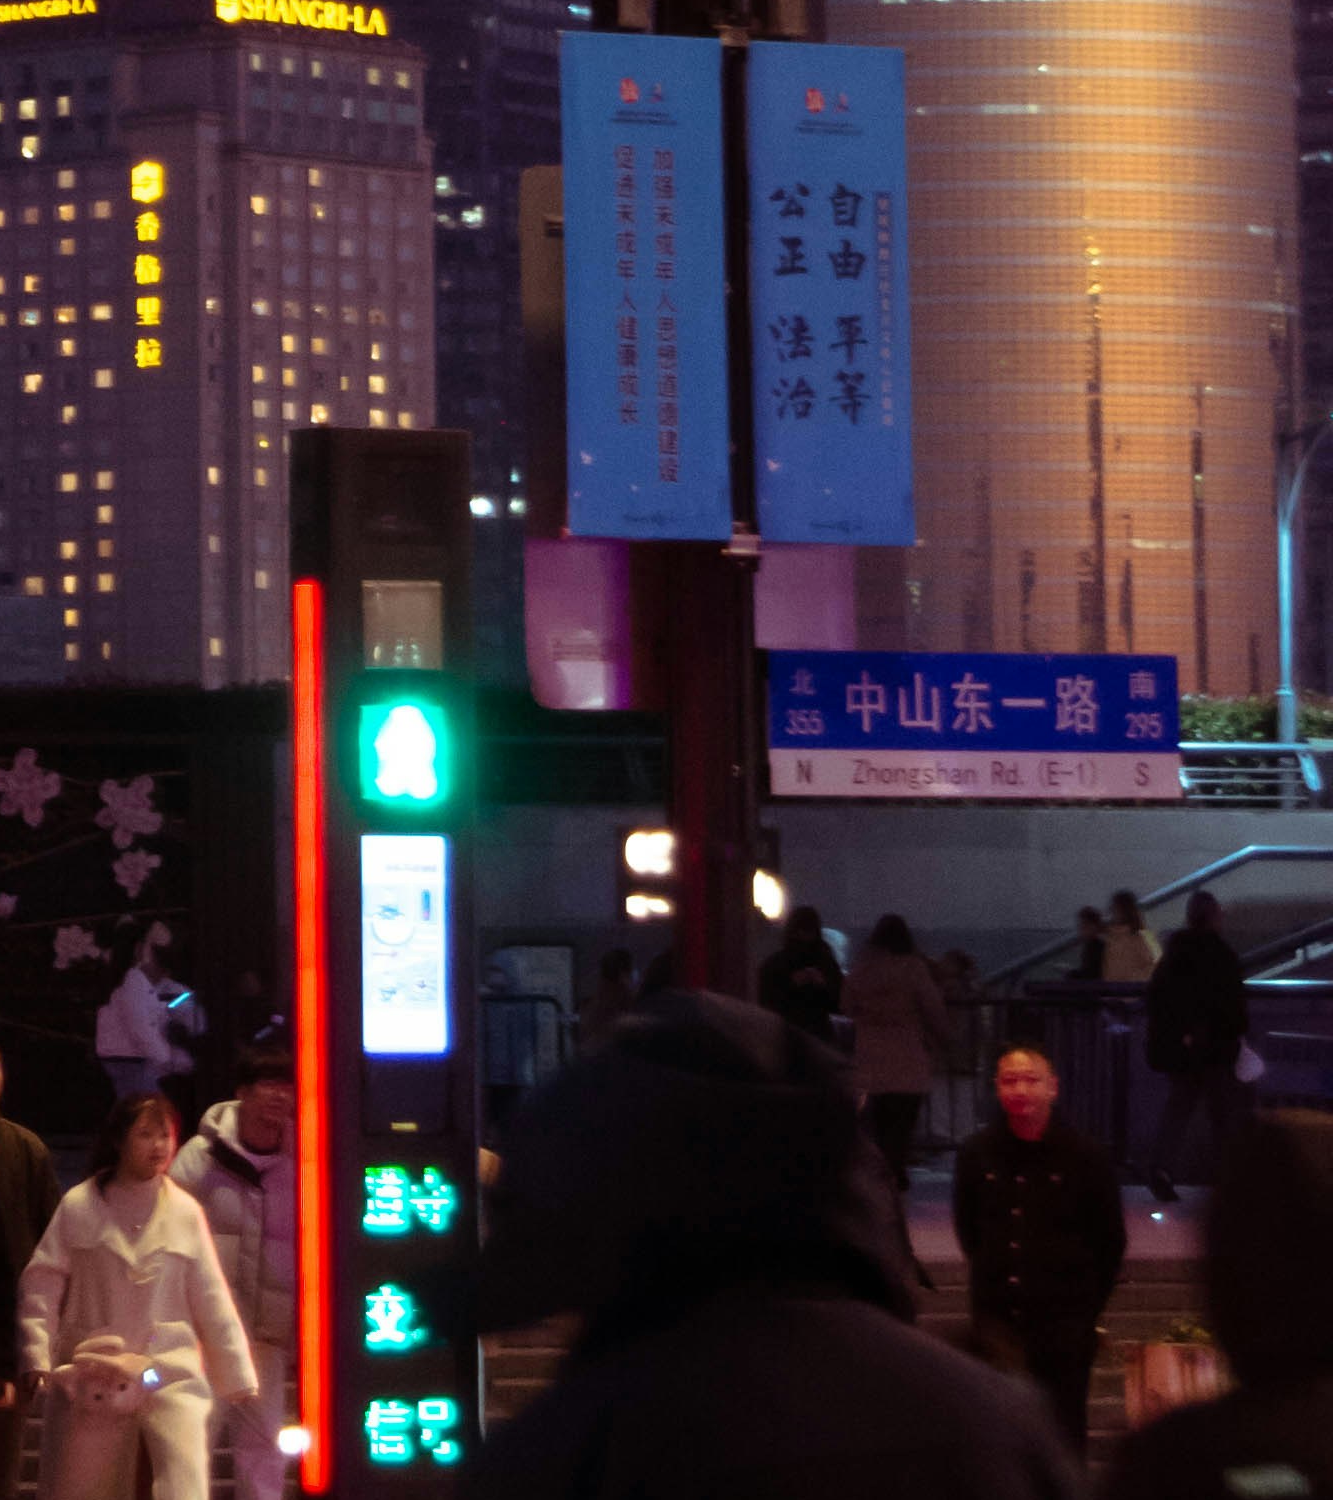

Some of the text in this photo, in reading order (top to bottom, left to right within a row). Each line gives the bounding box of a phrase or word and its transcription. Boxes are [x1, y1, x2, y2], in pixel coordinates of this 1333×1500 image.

[767, 183, 817, 420] 公正 法治
[829, 183, 872, 425] 自由 平等
[789, 667, 817, 696] 北
[1128, 670, 1156, 700] 南
[845, 669, 1101, 735] 中山东一路
[784, 709, 825, 737] 355
[1125, 712, 1164, 740] 295
[796, 760, 813, 785] N
[852, 758, 1098, 790] Zhongshan Rd. (E-1)
[1135, 762, 1150, 787] S
[365, 1400, 454, 1458] 信号
